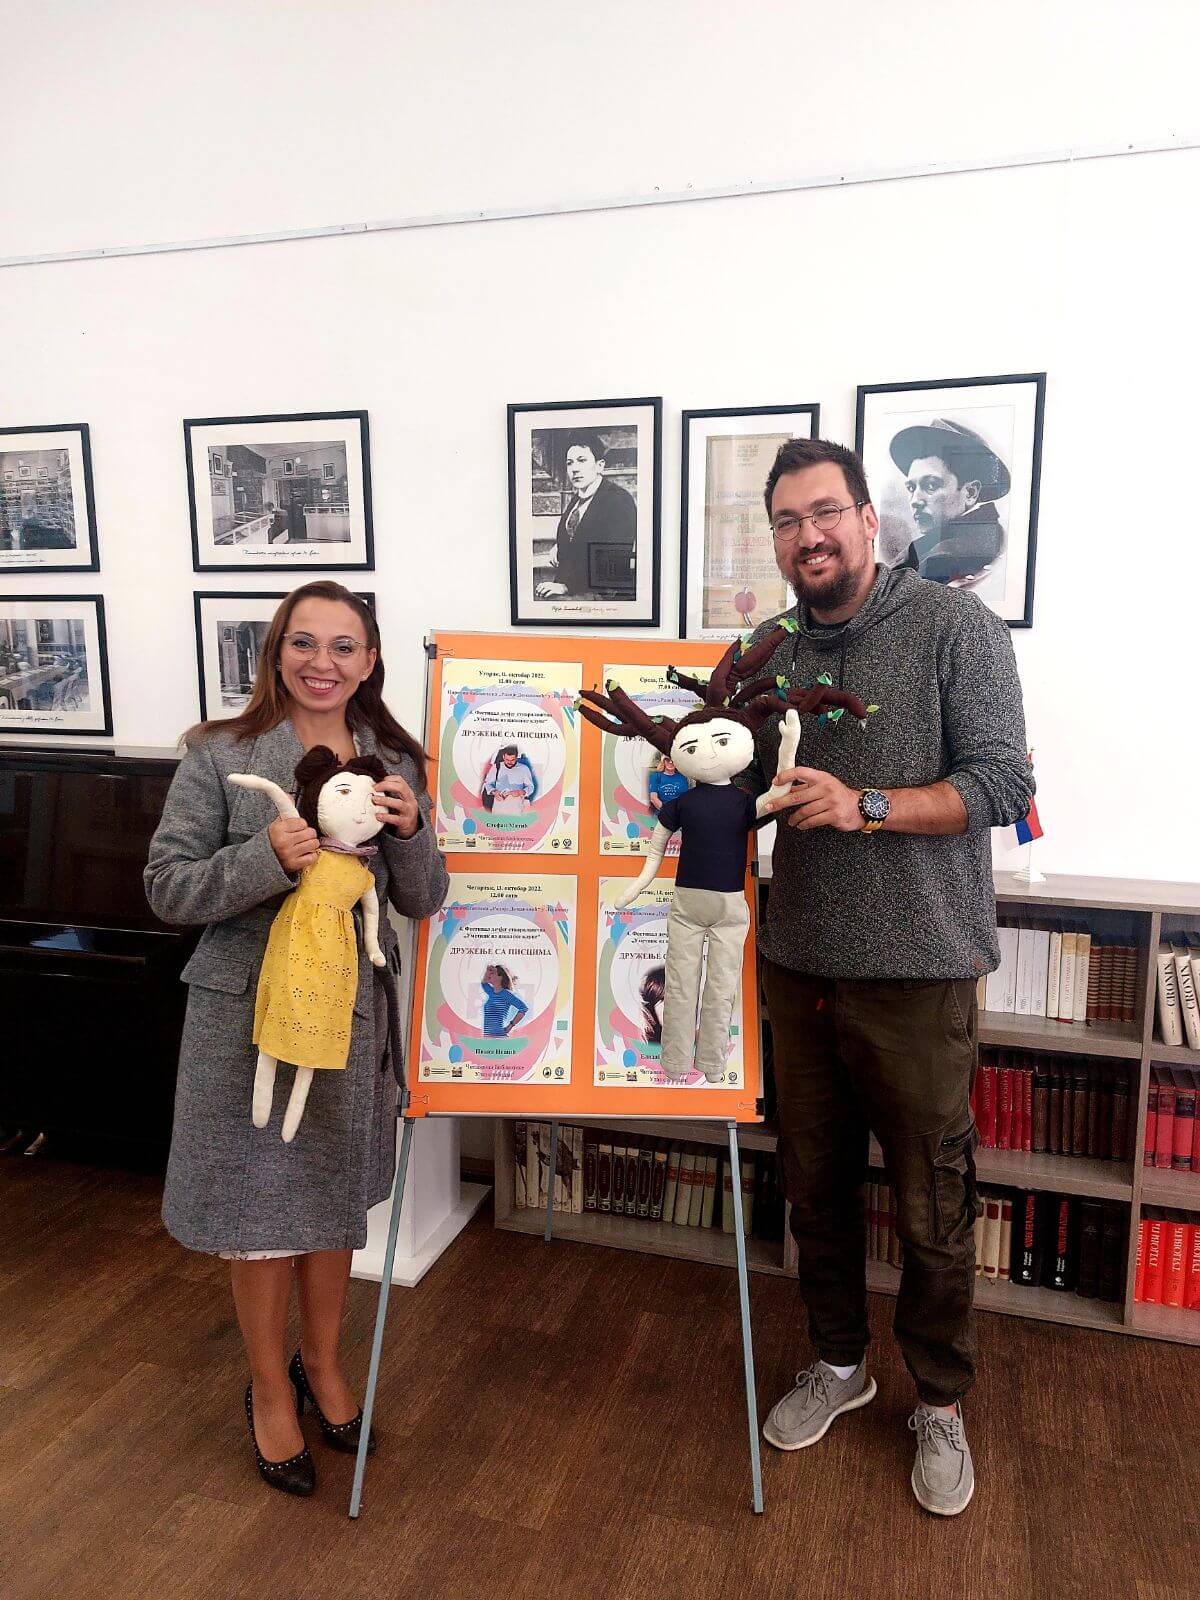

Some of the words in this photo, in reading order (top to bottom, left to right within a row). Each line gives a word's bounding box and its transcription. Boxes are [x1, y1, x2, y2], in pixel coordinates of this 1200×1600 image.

[461, 730, 502, 738] ДРУЖЕЊЕ
[1164, 964, 1176, 1007] CRONIN
[1180, 965, 1196, 1010] CRONIN
[1172, 1227, 1184, 1272] ТУЦОВИЋ
